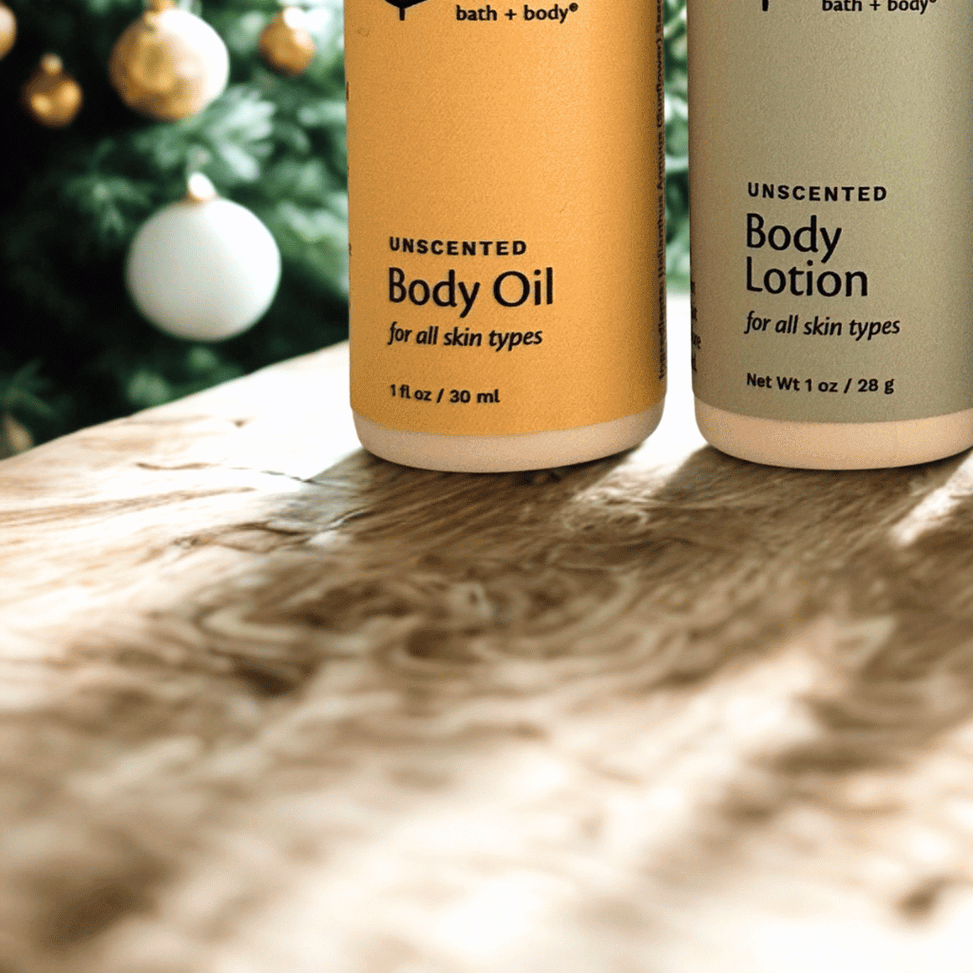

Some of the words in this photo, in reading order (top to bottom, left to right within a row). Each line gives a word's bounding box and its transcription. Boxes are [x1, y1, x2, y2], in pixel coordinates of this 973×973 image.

[455, 4, 498, 22] bath
[504, 8, 518, 21] +
[869, 0, 881, 11] +
[747, 181, 887, 202] UNSCENTED
[388, 236, 527, 256] UNSCENTED
[746, 212, 843, 263] Body
[746, 258, 868, 298] Lotion
[388, 266, 481, 319] Body
[492, 266, 554, 308] Oil
[386, 321, 413, 346] for
[415, 325, 439, 345] all
[443, 326, 483, 347] skin
[488, 329, 543, 353] types
[743, 310, 772, 335] for
[774, 314, 799, 335] all
[802, 315, 843, 337] skin
[848, 319, 901, 342] types
[390, 383, 397, 397] 1
[399, 384, 411, 400] fl
[413, 389, 432, 402] oz
[436, 388, 445, 404] /
[449, 389, 471, 404] 30
[476, 388, 501, 404] ml
[746, 372, 773, 389] Net
[776, 375, 801, 392] Wt
[804, 378, 812, 393] 1
[817, 381, 839, 393] oz
[843, 377, 853, 394] /
[857, 378, 879, 393] 28
[883, 378, 895, 395] g
